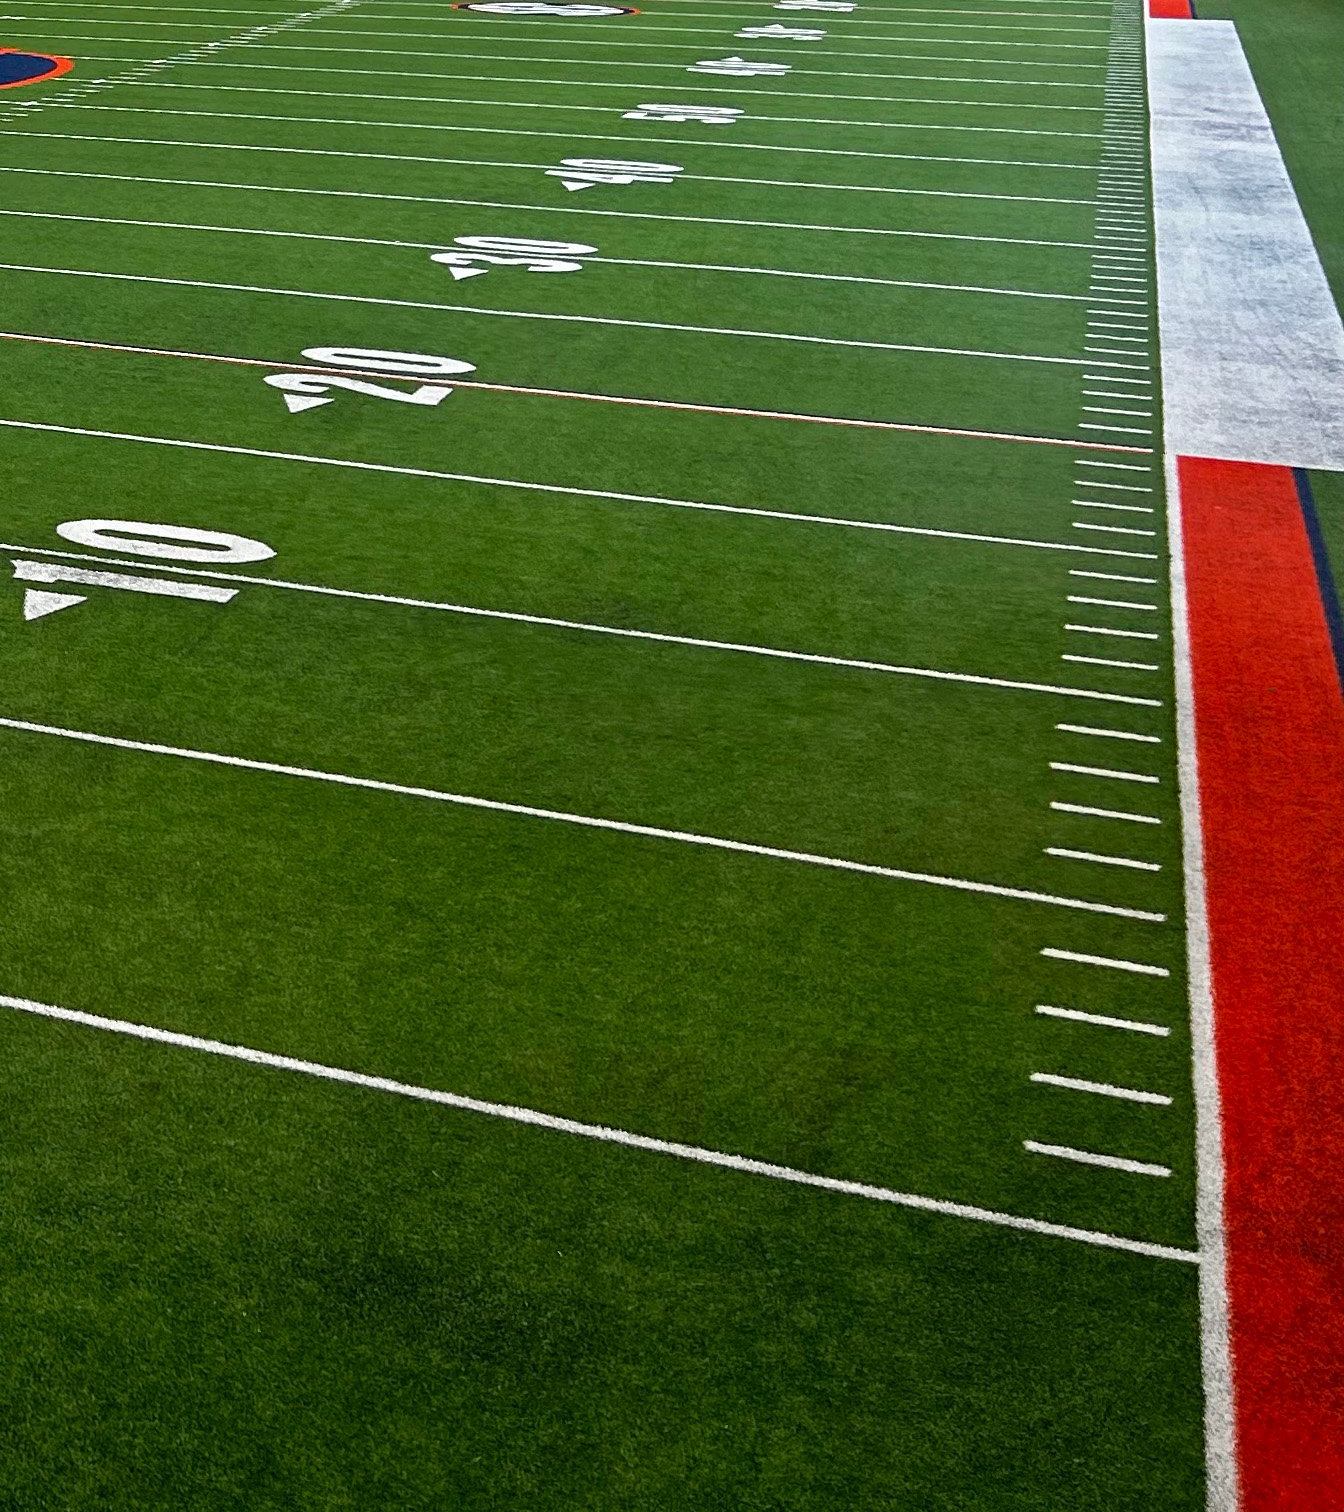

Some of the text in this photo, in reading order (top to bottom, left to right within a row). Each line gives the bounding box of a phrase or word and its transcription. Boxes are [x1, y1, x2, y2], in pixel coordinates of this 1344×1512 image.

[429, 235, 600, 273] 30
[262, 346, 478, 407] 20
[11, 518, 278, 604] 10
